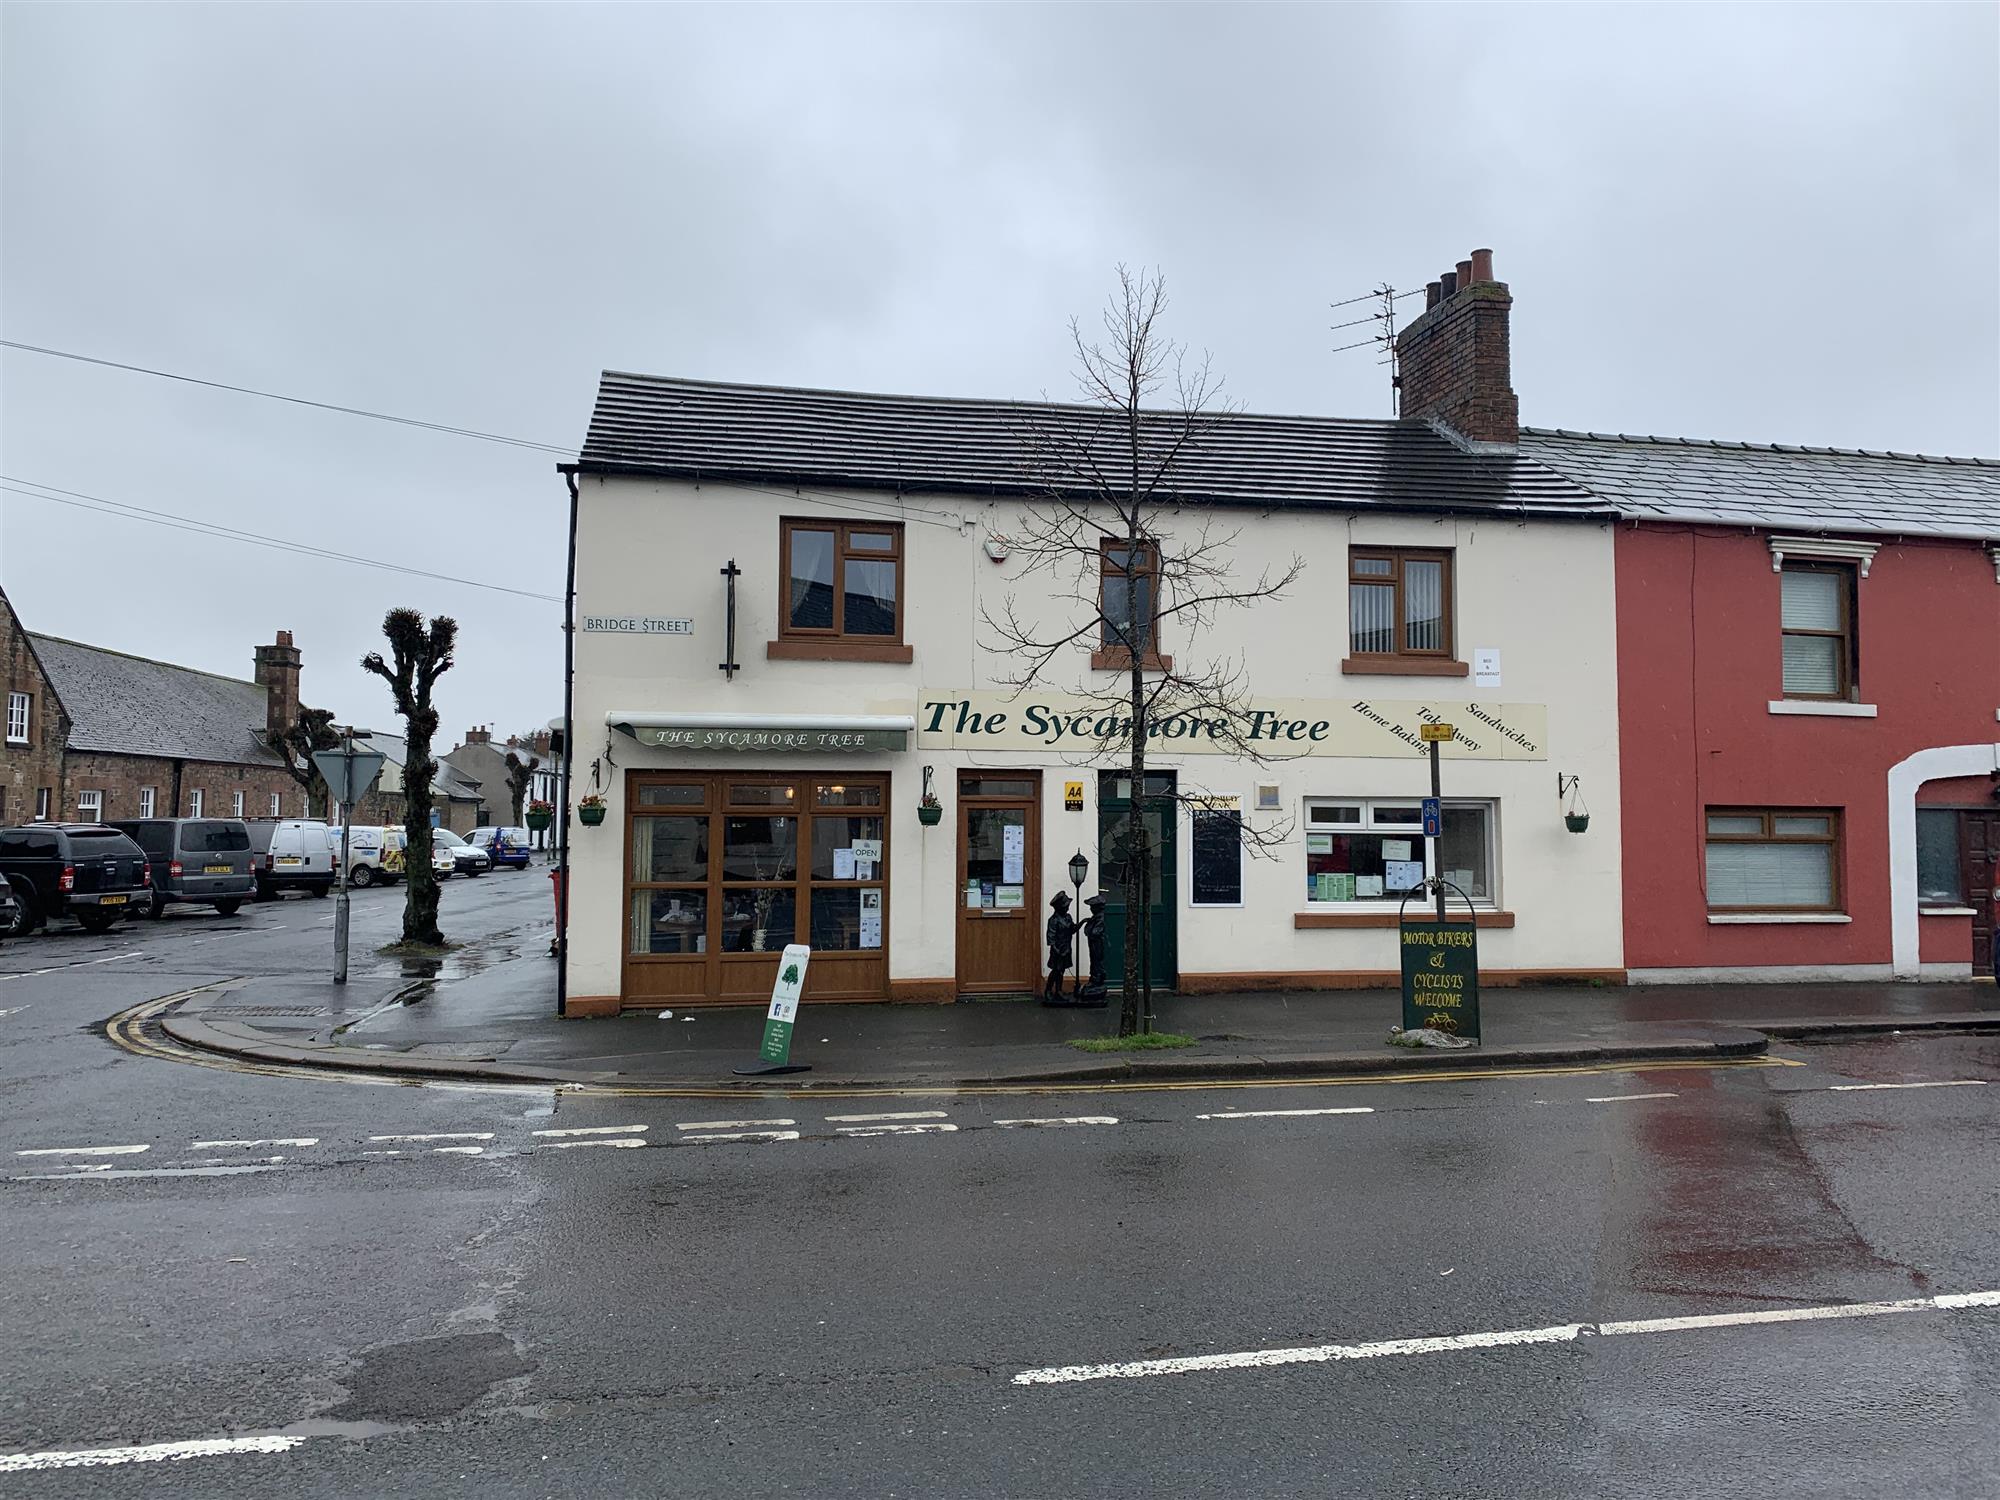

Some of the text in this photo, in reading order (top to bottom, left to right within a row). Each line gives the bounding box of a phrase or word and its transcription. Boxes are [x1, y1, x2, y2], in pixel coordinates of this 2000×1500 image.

[587, 618, 690, 632] BRIDGE STREET
[923, 700, 1006, 734] The
[1246, 710, 1330, 742] Tree
[1416, 706, 1445, 725] Tak
[1352, 700, 1431, 756] Home Baking
[1465, 702, 1538, 753] Sandwiches
[656, 731, 865, 747] THE SYCAMORE TREE
[1067, 786, 1082, 798] AA
[855, 848, 878, 857] OPEN
[1403, 931, 1473, 948] MOTOR BIKERS
[1413, 973, 1464, 990] CYCLISTS
[1413, 992, 1462, 1008] WELCOME
